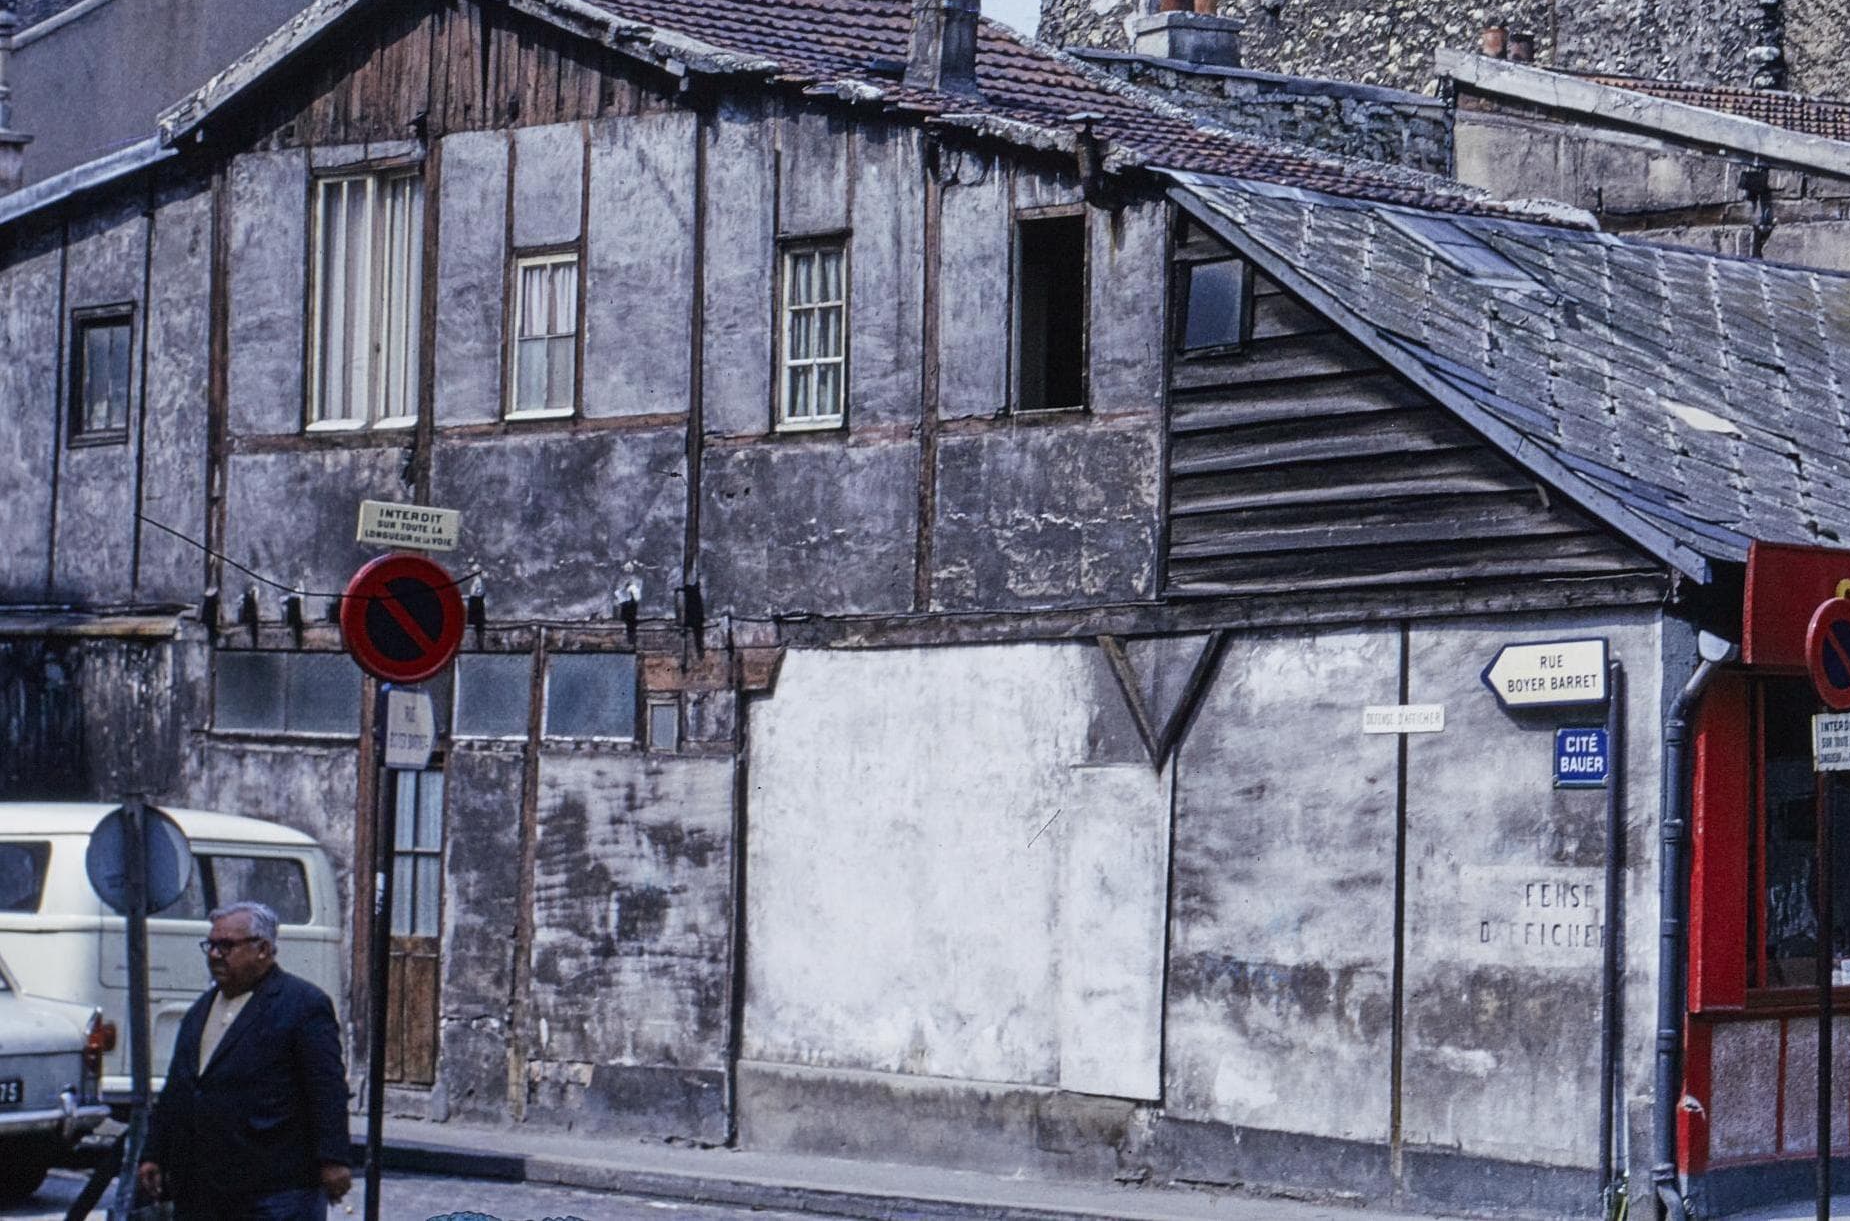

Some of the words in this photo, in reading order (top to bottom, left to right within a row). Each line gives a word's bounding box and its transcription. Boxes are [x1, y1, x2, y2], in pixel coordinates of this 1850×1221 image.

[379, 508, 443, 524] INTERDIT
[377, 520, 396, 529] SUR
[401, 522, 428, 533] TOUTE
[432, 526, 443, 534] LA
[364, 529, 412, 542] LONGUEUR
[432, 538, 452, 546] VOIE
[1540, 654, 1564, 669] RUE
[1507, 677, 1546, 693] BOYER
[1551, 674, 1598, 690] BARRET
[1565, 733, 1599, 753] CITÉ
[1560, 755, 1604, 773] BAUER
[1525, 883, 1595, 908] FENSE
